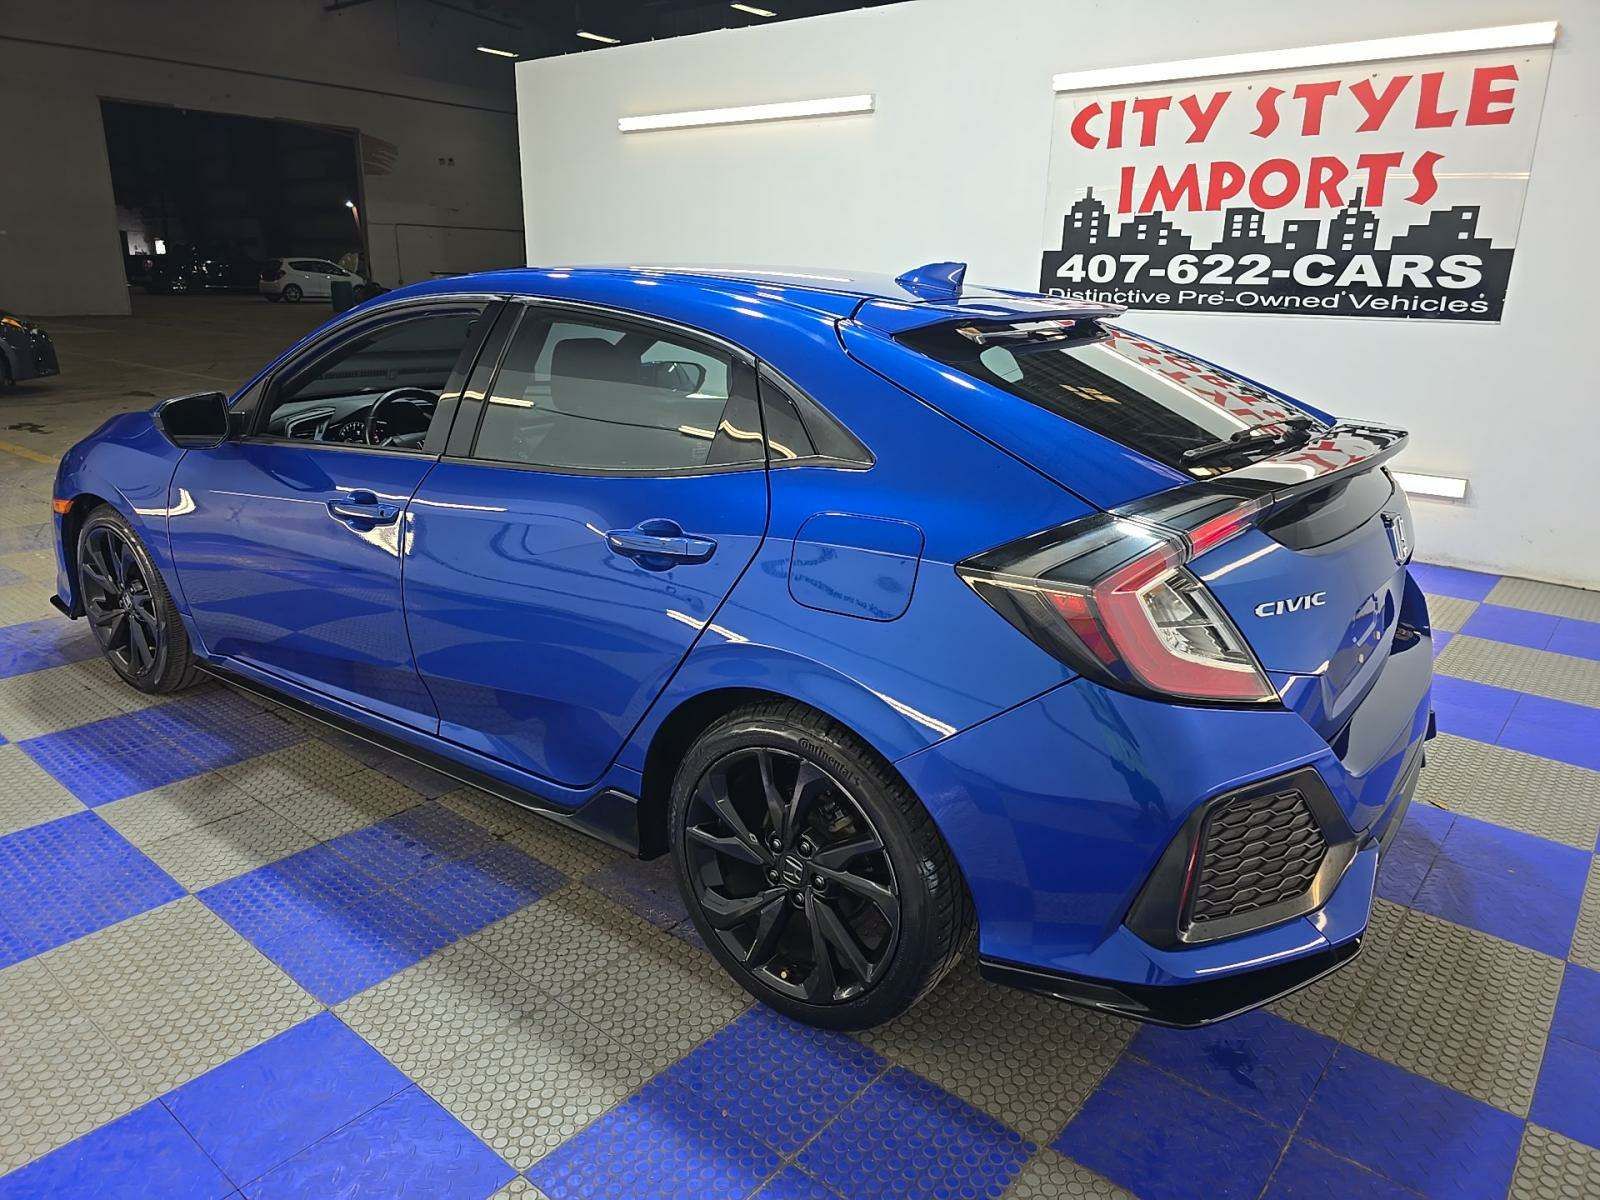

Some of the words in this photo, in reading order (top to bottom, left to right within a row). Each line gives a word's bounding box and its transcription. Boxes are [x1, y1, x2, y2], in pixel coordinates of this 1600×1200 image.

[1070, 92, 1230, 149] CITY
[1251, 65, 1519, 137] STYLE
[1118, 152, 1444, 213] IMPORTS
[1056, 254, 1483, 288] 407-622-CARS
[1048, 287, 1171, 304] Distinctive
[1178, 290, 1340, 309] Pre-Owned
[1348, 293, 1489, 313] Vehicles
[1254, 591, 1327, 618] CIVIC
